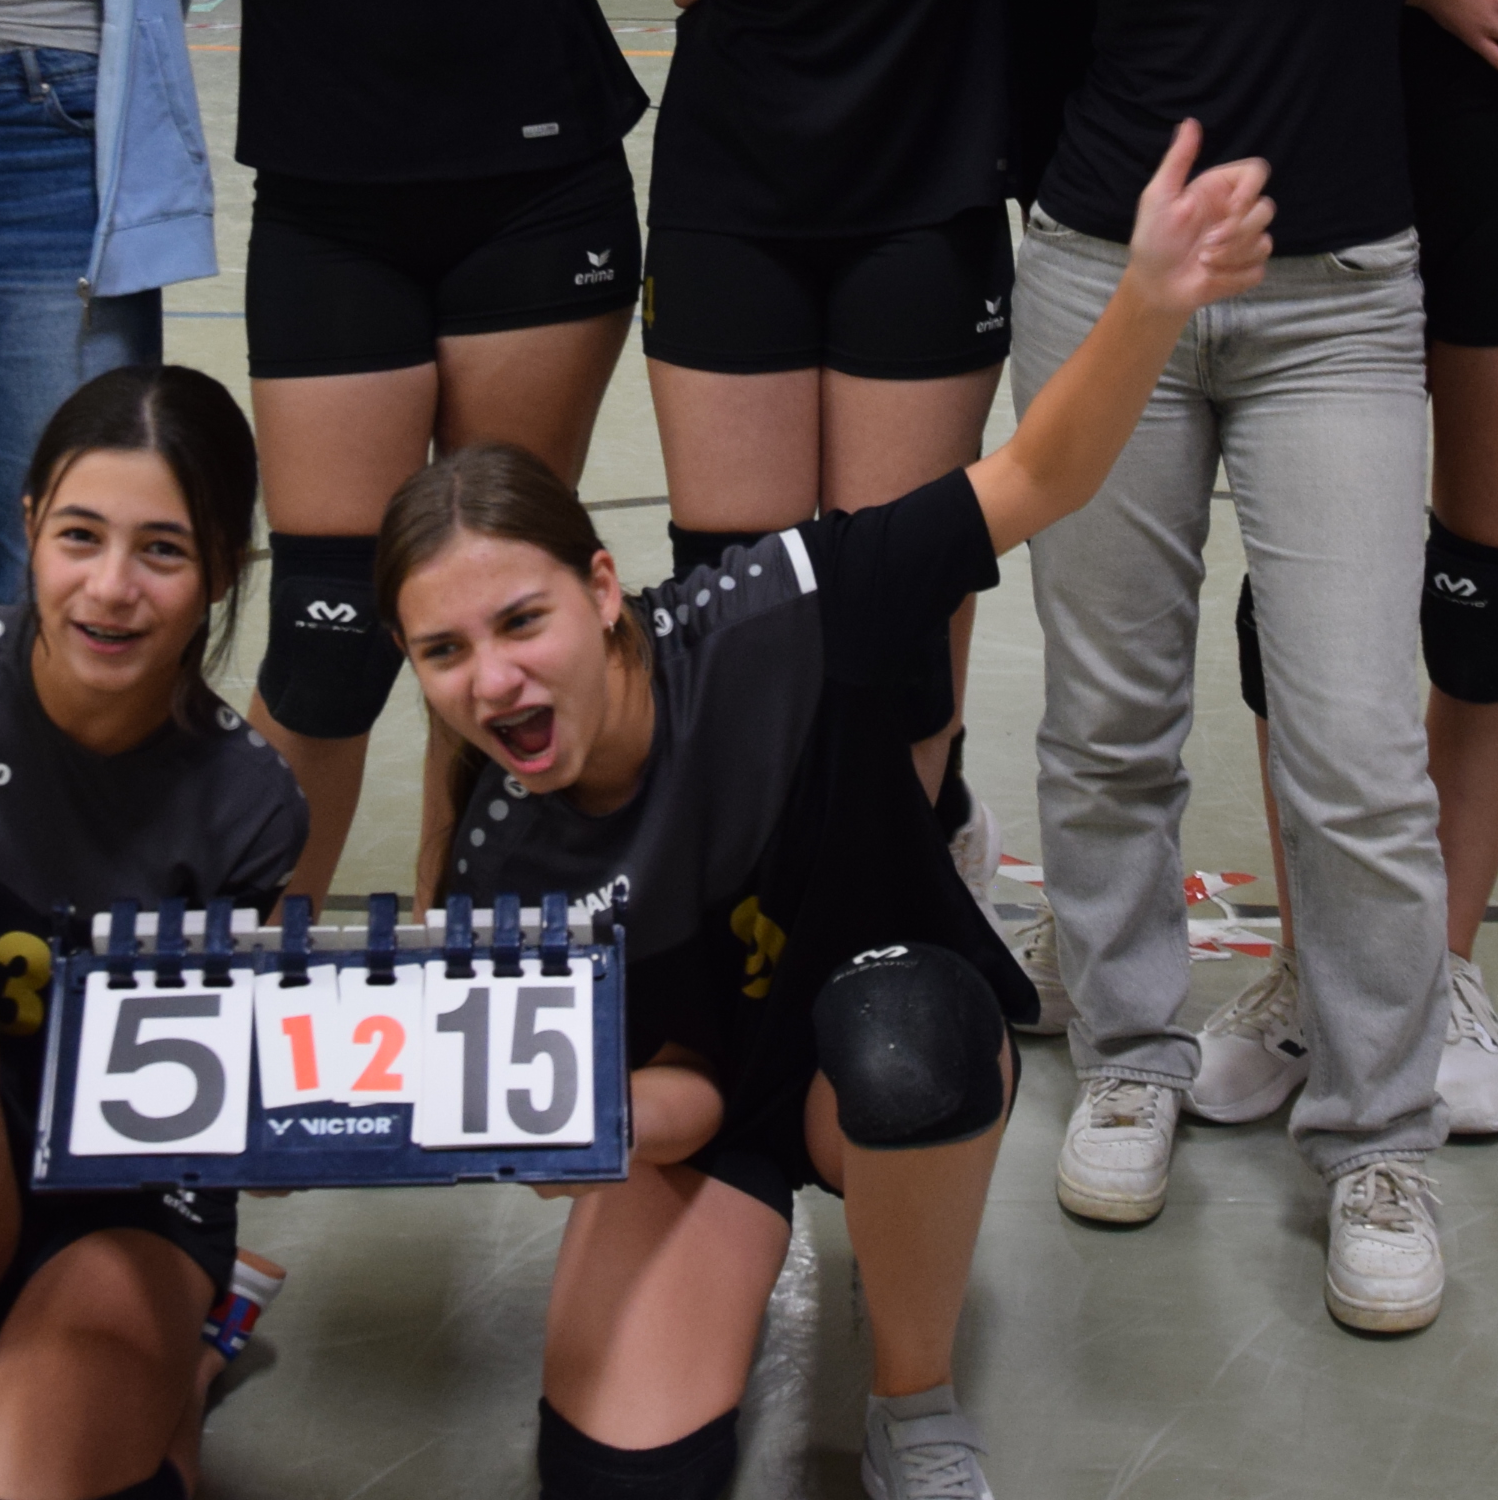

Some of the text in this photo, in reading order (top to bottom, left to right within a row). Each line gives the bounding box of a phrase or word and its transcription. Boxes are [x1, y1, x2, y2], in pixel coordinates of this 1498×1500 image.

[573, 268, 615, 286] erima
[574, 874, 630, 916] AKO
[99, 994, 227, 1144] 5
[435, 985, 579, 1136] 15
[298, 1116, 393, 1136] VICTOR
